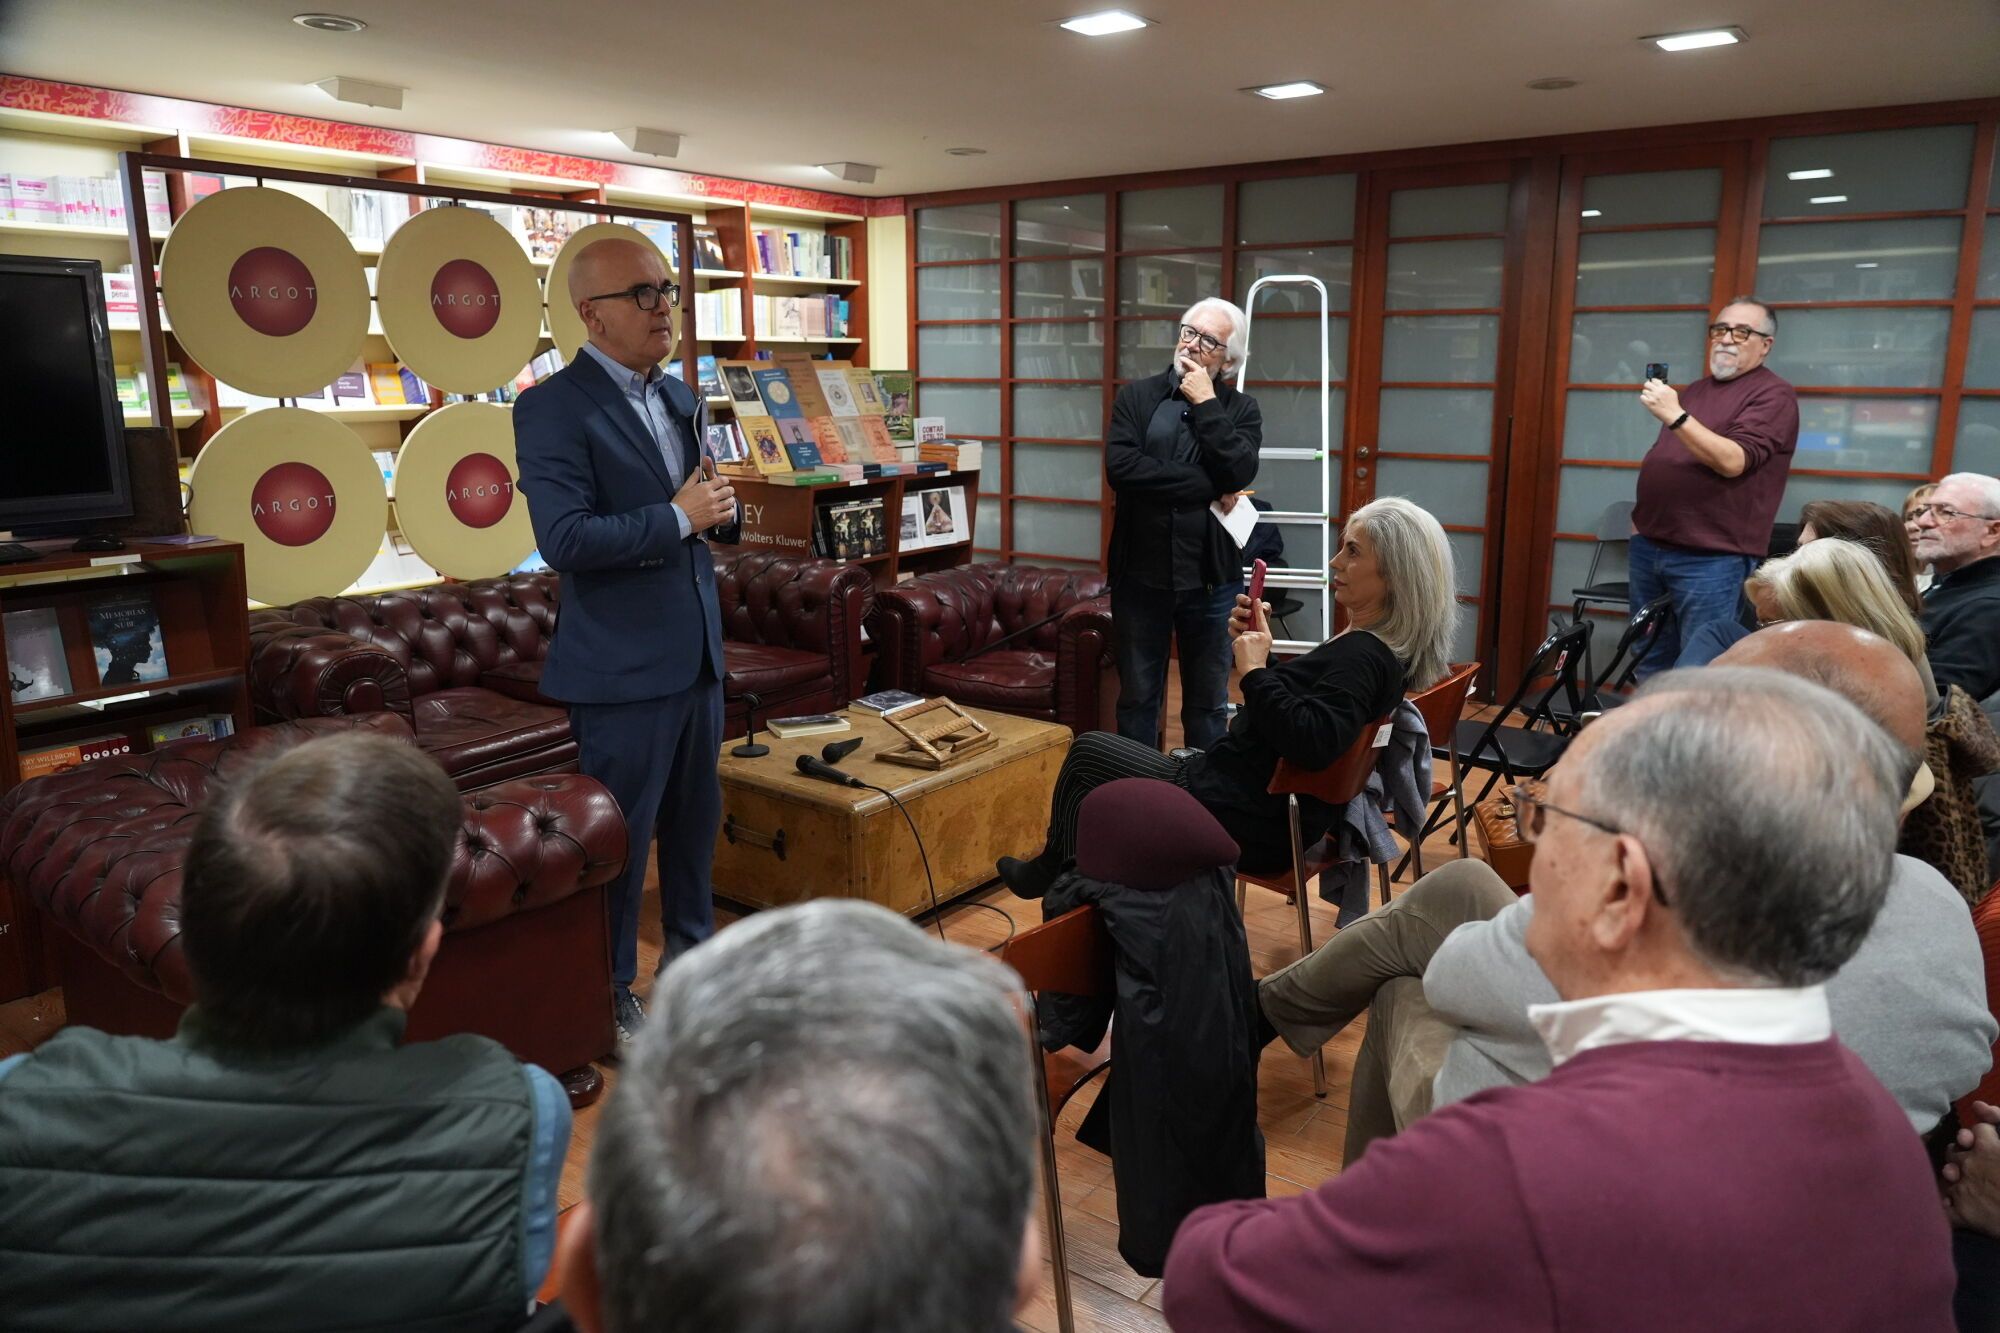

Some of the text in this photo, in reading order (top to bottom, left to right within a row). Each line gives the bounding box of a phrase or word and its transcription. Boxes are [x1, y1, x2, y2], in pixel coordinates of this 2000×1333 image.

[231, 286, 315, 300] ARGOT
[433, 294, 499, 306] ARGOT
[448, 482, 512, 500] ARGOT
[254, 495, 334, 516] ARGOT
[742, 504, 764, 525] EY
[741, 531, 807, 548] Wolters Kluwer
[100, 608, 146, 620] MEMORIAS
